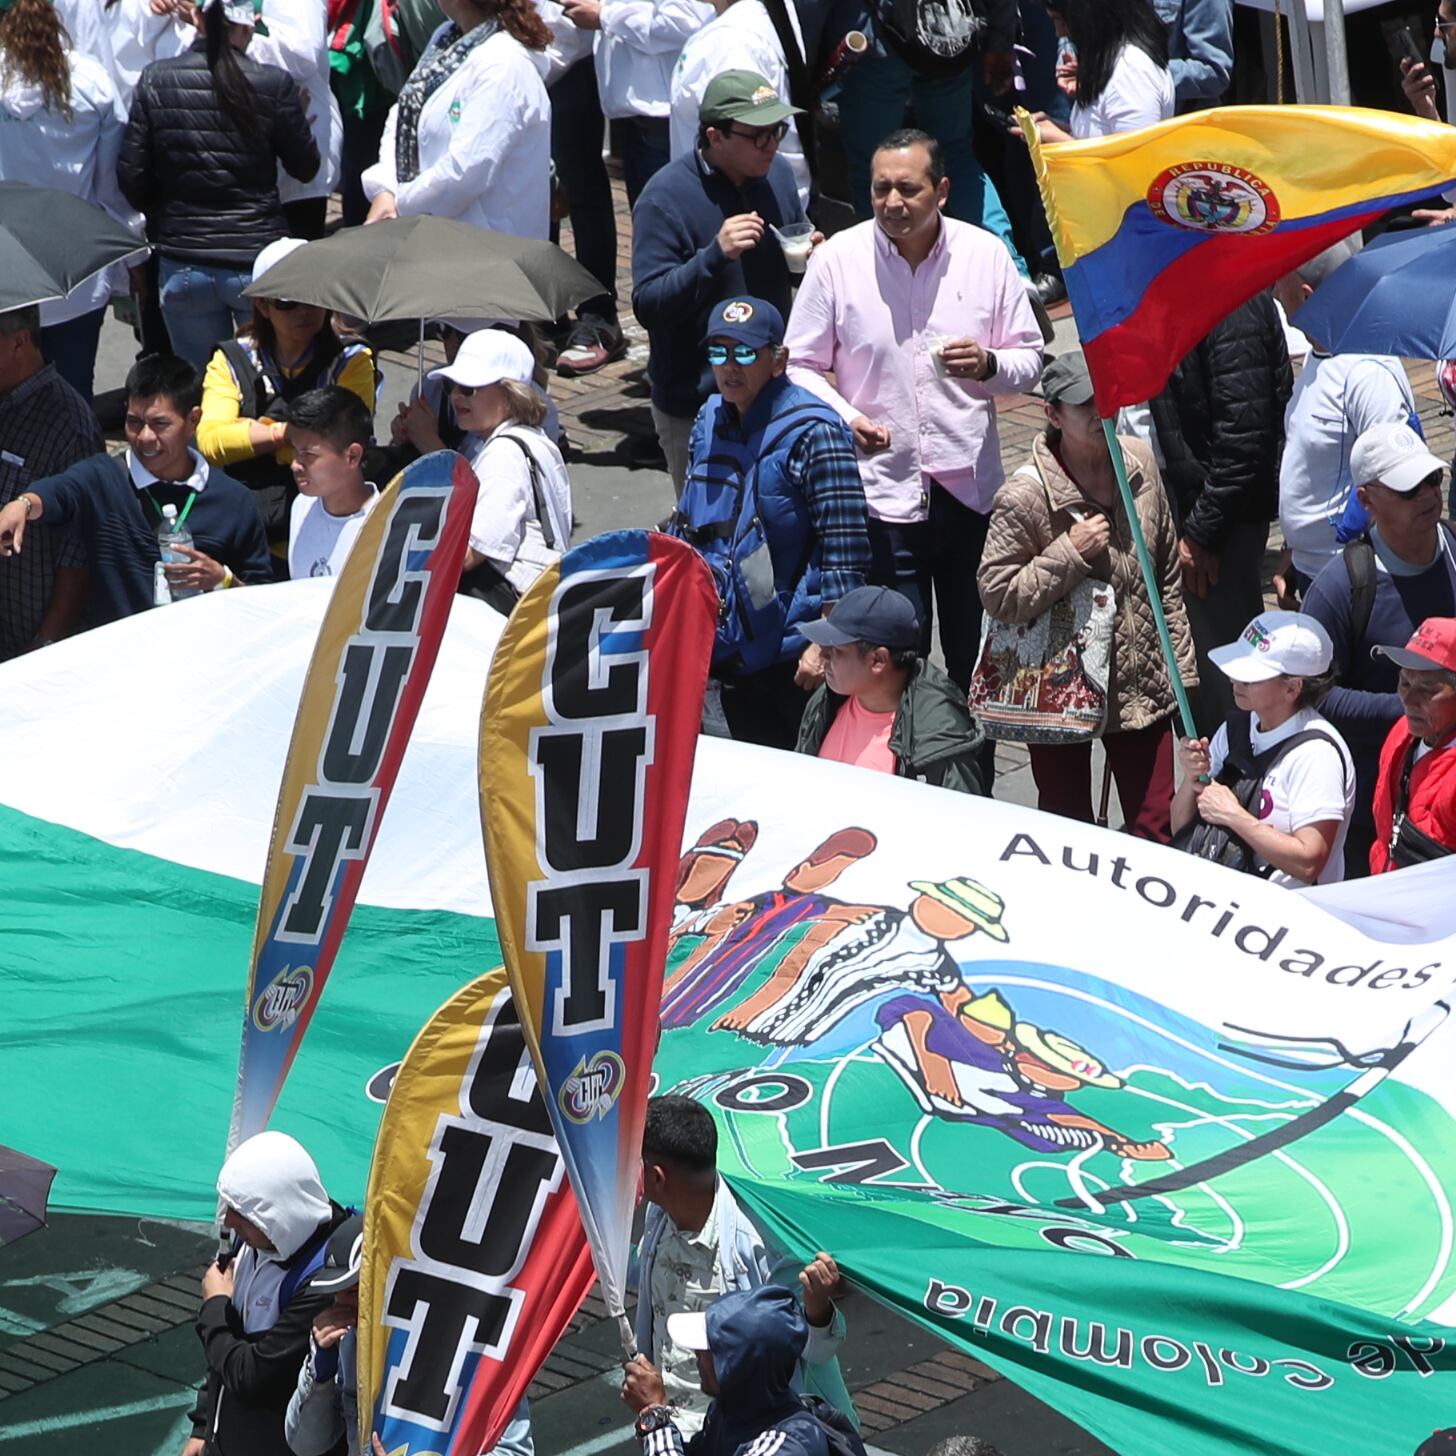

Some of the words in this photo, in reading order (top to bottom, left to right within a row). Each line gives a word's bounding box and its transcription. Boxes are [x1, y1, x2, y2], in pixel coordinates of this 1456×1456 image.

[1168, 161, 1271, 197] REPUBLICA
[277, 487, 451, 943] CUT
[528, 566, 655, 1035] CUT
[999, 832, 1443, 991] Autoridades
[382, 987, 565, 1431] CUT
